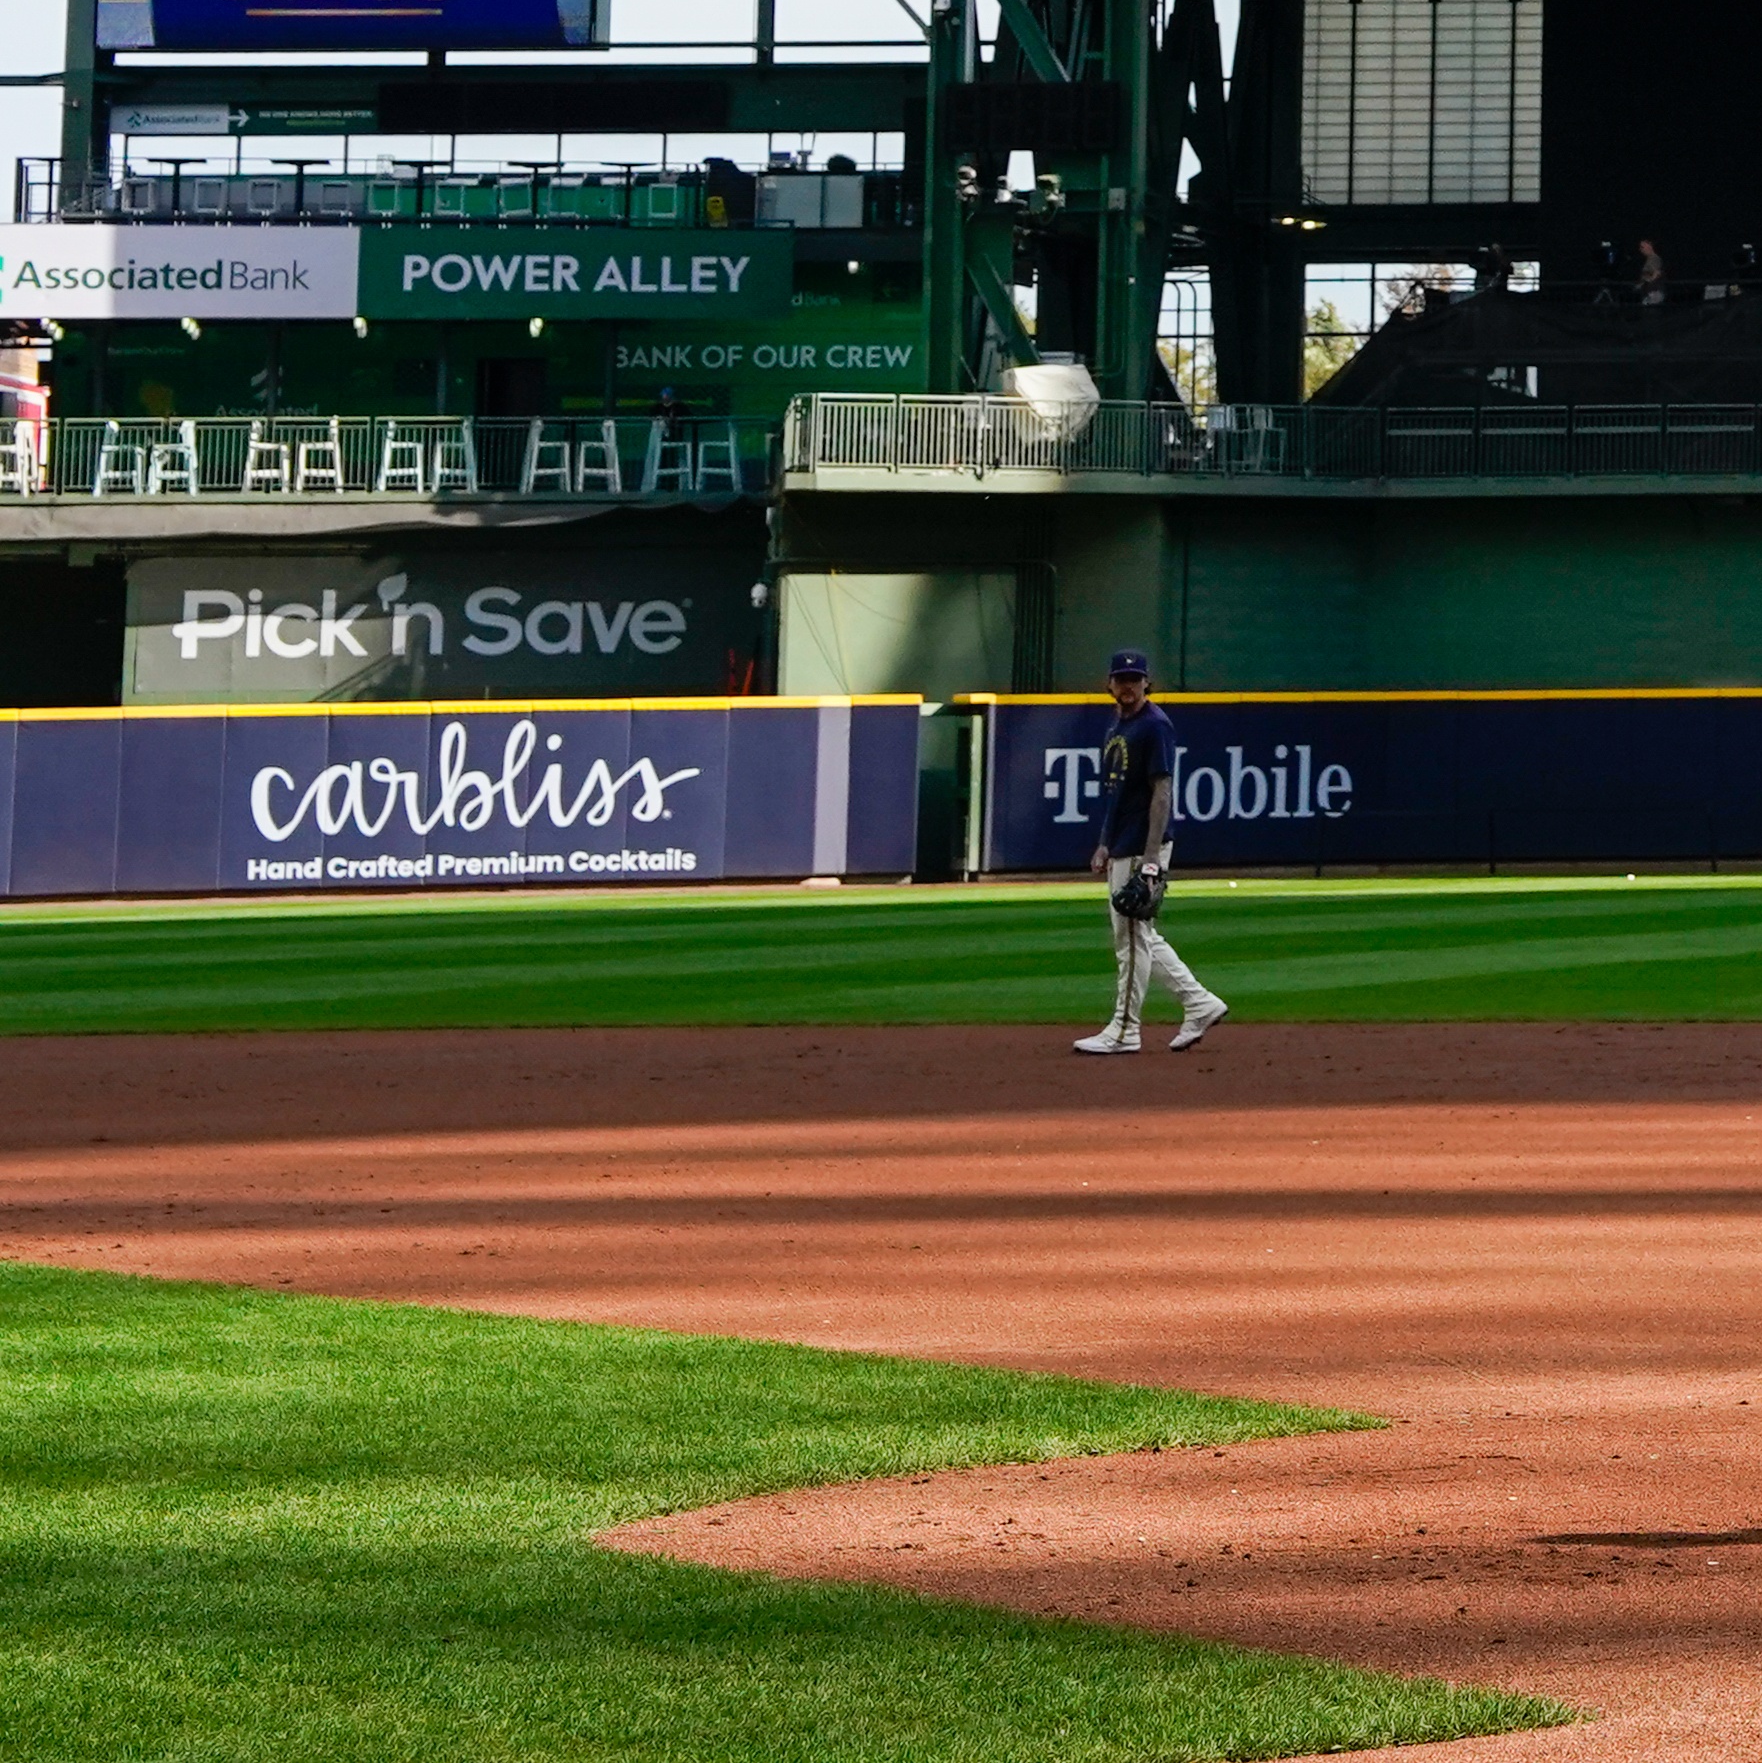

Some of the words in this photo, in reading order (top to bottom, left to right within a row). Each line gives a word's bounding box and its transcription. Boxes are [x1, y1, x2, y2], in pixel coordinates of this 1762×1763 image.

[403, 253, 581, 292] POWER
[593, 256, 751, 293] ALLEY
[701, 345, 743, 368] OF
[753, 344, 816, 368] OUR
[826, 344, 913, 368] CREW
[172, 588, 368, 659] Pick
[463, 586, 688, 655] Save
[250, 719, 700, 842] carbliss
[1172, 744, 1353, 822] obile
[247, 857, 323, 881] Hand
[327, 852, 433, 880] Crafted
[437, 848, 564, 876] Premium
[569, 847, 697, 874] Cocktails
